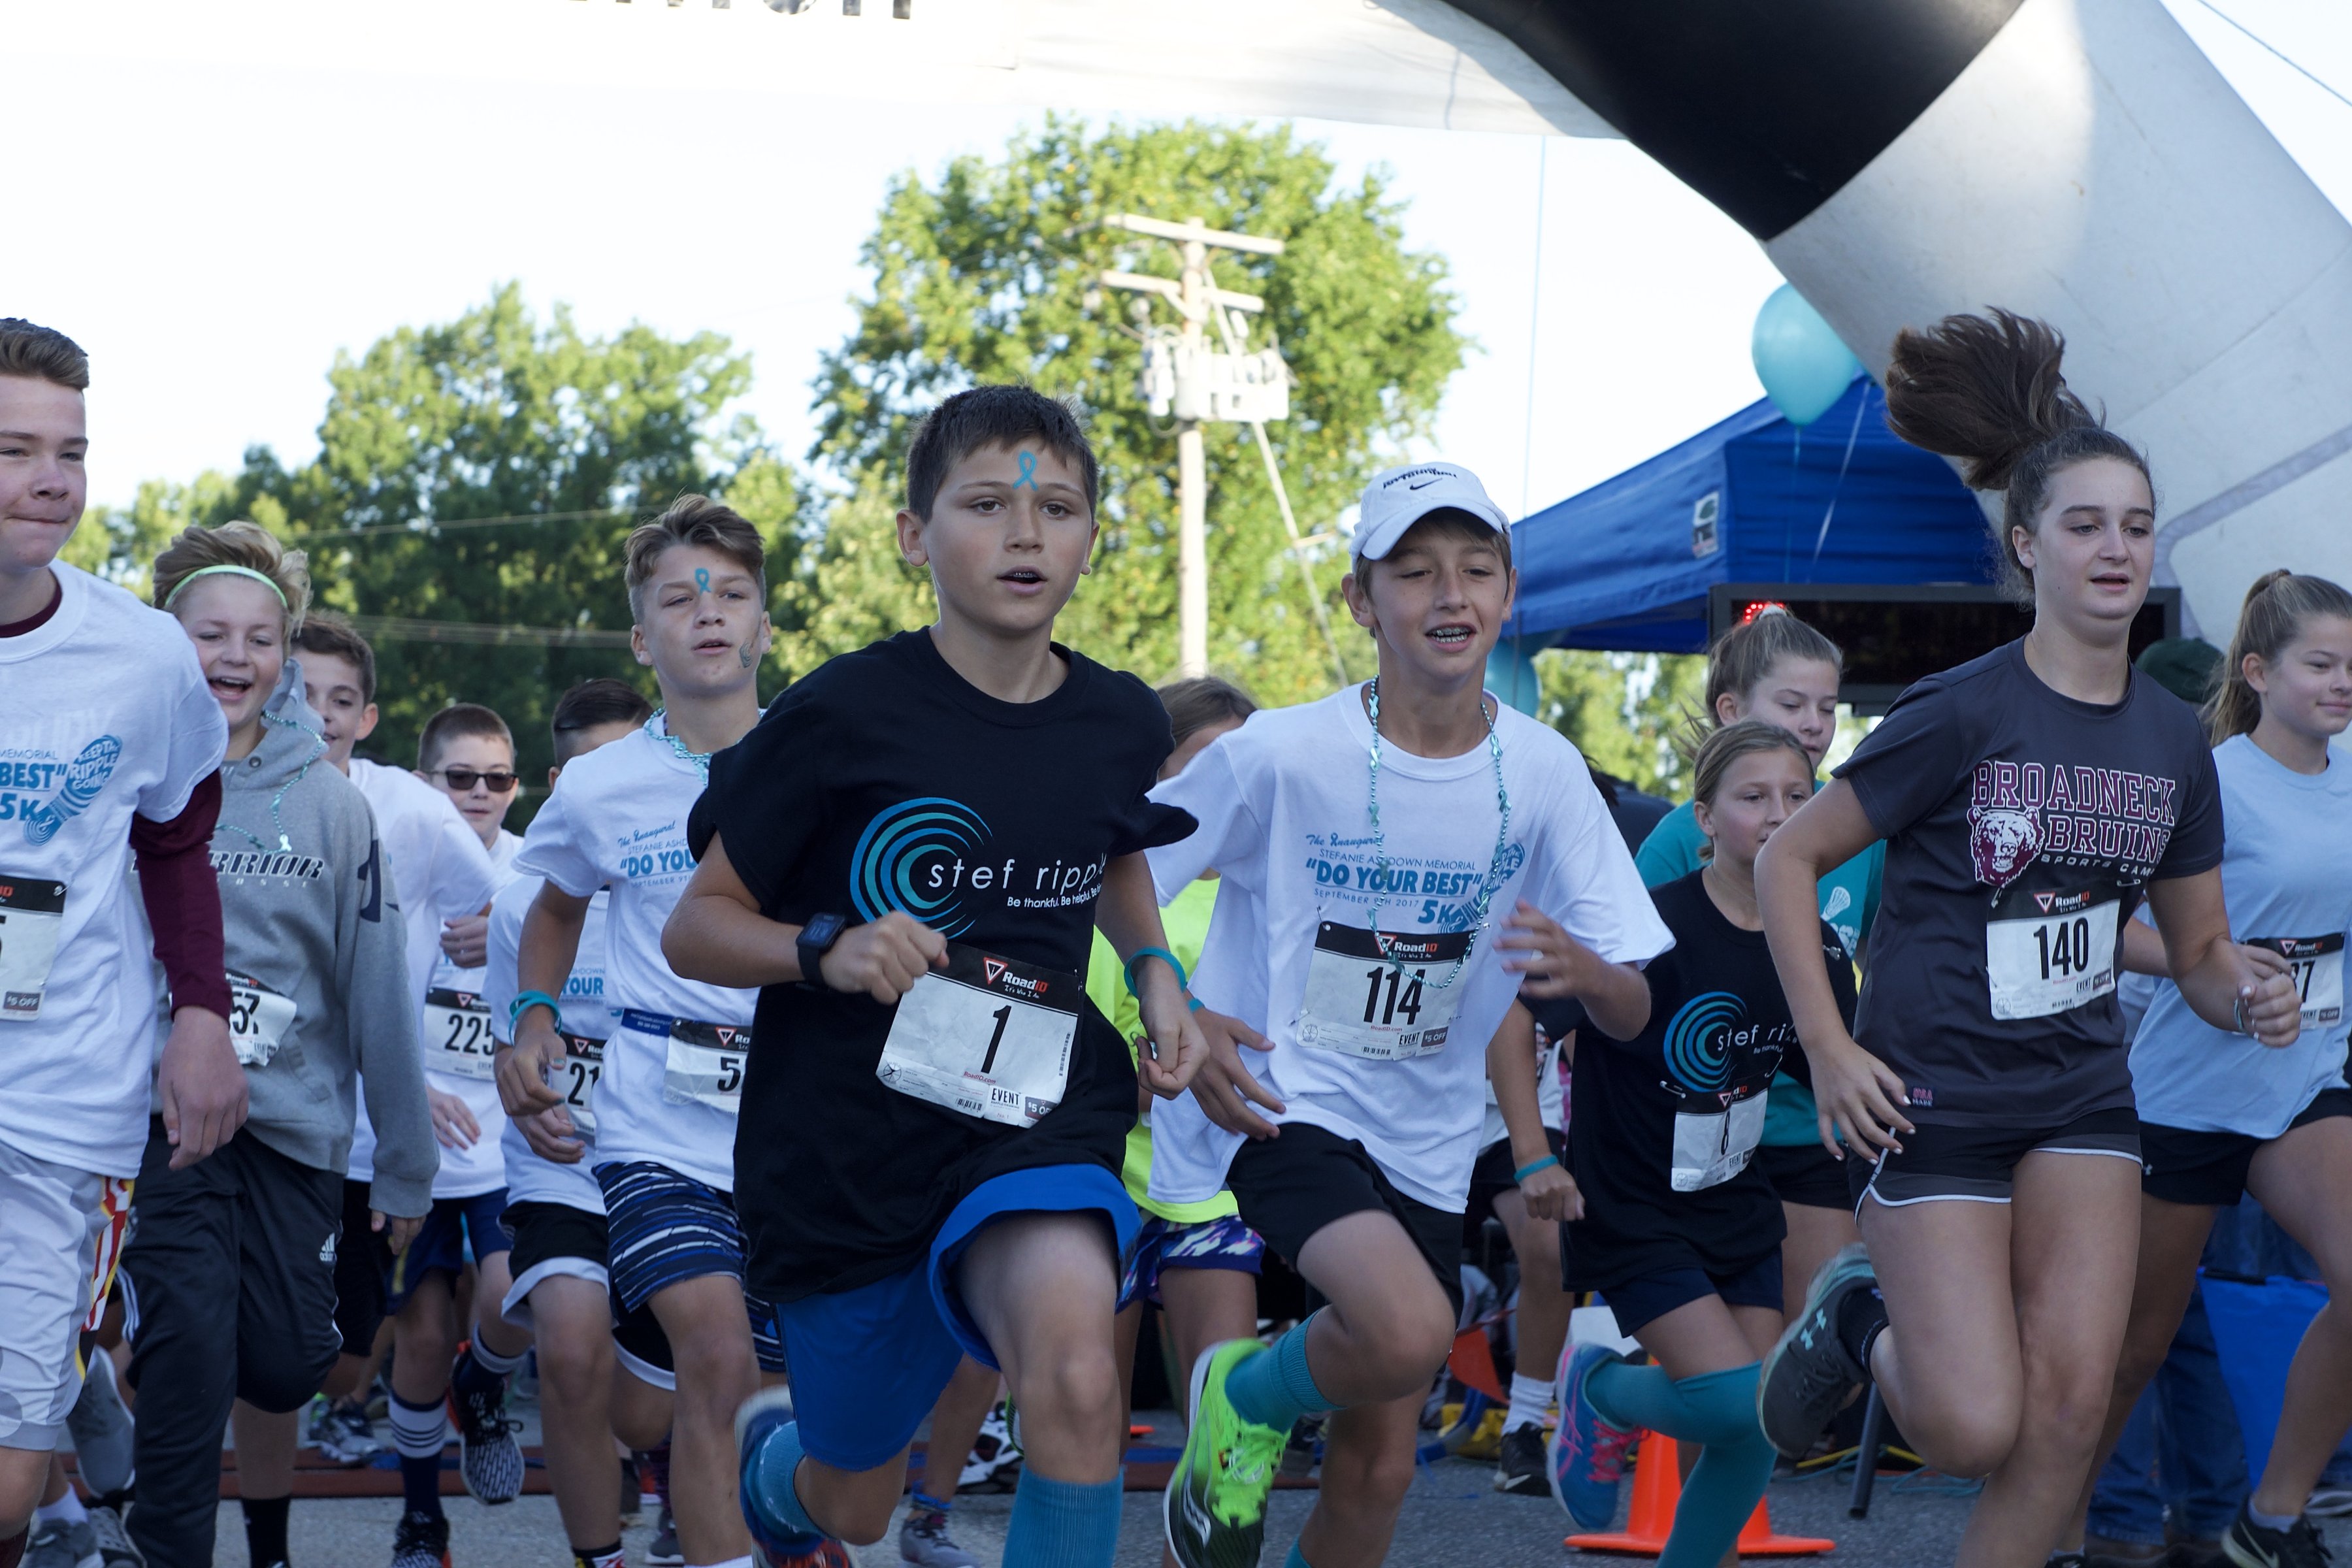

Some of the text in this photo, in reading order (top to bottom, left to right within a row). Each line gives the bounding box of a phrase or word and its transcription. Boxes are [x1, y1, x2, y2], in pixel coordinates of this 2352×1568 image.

[69, 752, 118, 781] RIPPLE
[0, 792, 41, 821] 5K
[1972, 760, 2176, 826] BROADNECK
[617, 820, 676, 848] The Inaugural
[627, 838, 688, 855] STEFANIE ASHD
[1307, 834, 1324, 846] The
[2045, 814, 2171, 864] BRUINS
[620, 849, 698, 877] "DO YOU
[928, 858, 1015, 889] stef
[1319, 849, 1365, 864] STEFANIE
[1367, 856, 1423, 868] ASDOWN
[1425, 860, 1476, 871] MEMORIAL
[2041, 853, 2111, 868] SPORTS
[1306, 858, 1483, 896] "DO YOUR BEST"
[1007, 896, 1021, 907] Be
[1024, 896, 1060, 908] thankful.
[1061, 894, 1071, 906] Be
[1315, 888, 1369, 905] SEPTEMBER
[1396, 899, 1420, 908] 2017
[2033, 917, 2089, 980] 140
[1002, 971, 1049, 992] RoadID
[1364, 966, 1426, 1025] 114
[18, 994, 39, 1007] OFF
[445, 1014, 495, 1056] 225
[981, 1005, 1011, 1074] 1
[1399, 1032, 1420, 1045] EVENT
[1433, 1032, 1446, 1041] OFF
[1718, 1024, 1759, 1051] stef
[963, 1071, 996, 1085] RoadID.com
[992, 1088, 1019, 1105] EVENT
[1720, 1111, 1730, 1155] 8
